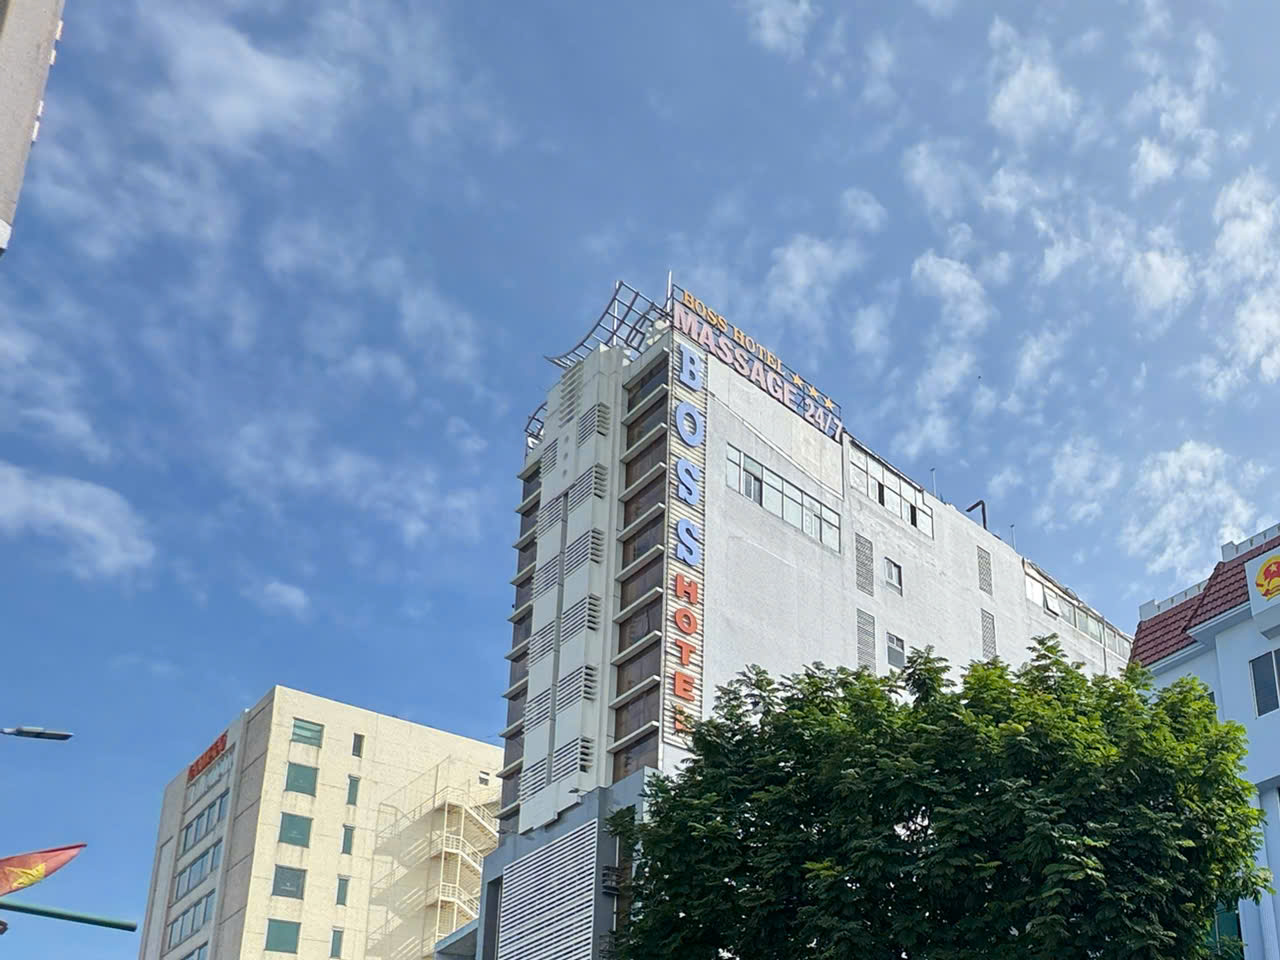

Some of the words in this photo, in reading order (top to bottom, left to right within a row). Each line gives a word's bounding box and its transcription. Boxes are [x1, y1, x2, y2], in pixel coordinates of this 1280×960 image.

[674, 300, 802, 411] MASSAGE
[804, 398, 843, 442] 24/7
[683, 290, 729, 332] BOSS
[733, 327, 783, 373] HOTEL
[675, 343, 705, 566] BOSS
